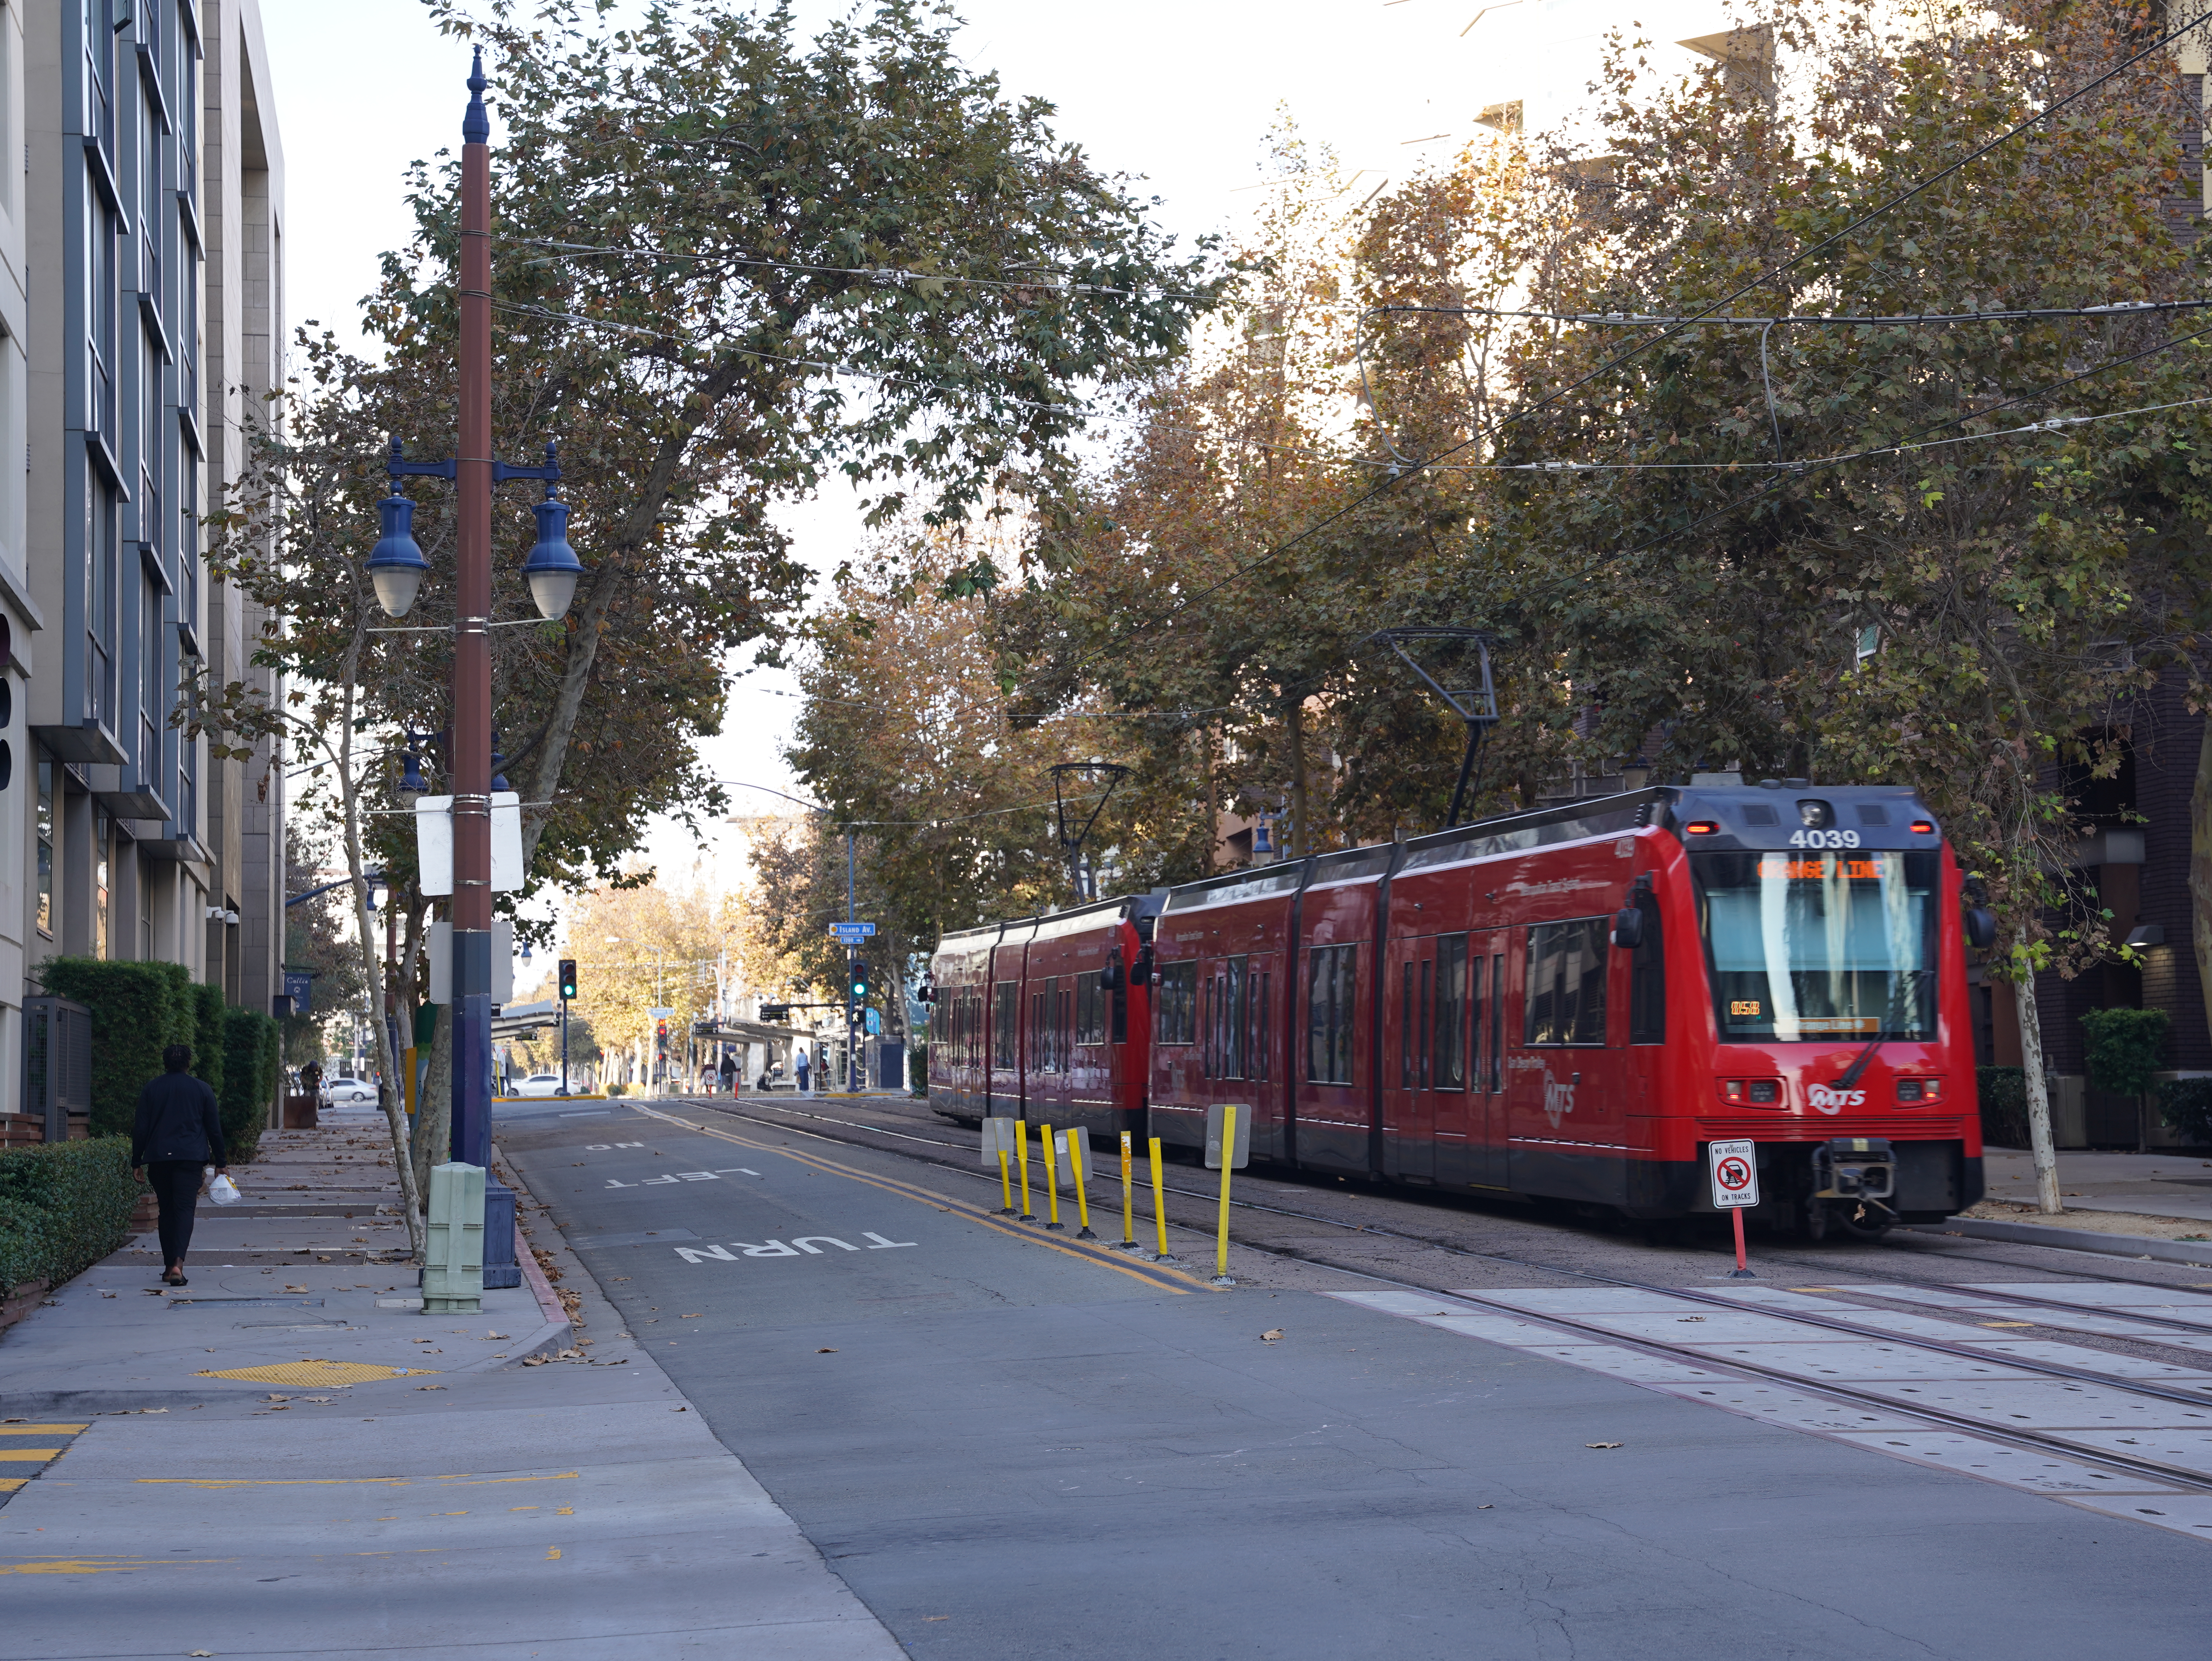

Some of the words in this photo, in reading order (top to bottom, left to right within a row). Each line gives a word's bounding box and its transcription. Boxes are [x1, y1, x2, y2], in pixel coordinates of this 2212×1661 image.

[1789, 830, 1861, 849] 4039
[1757, 861, 1828, 879] ORANGE
[1836, 861, 1884, 879] LINE
[1831, 1019, 1853, 1030] Line
[1544, 1084, 1576, 1113] MTS
[1808, 1090, 1867, 1106] MTS
[604, 1168, 761, 1189] LEFT
[673, 1232, 919, 1263] TURN
